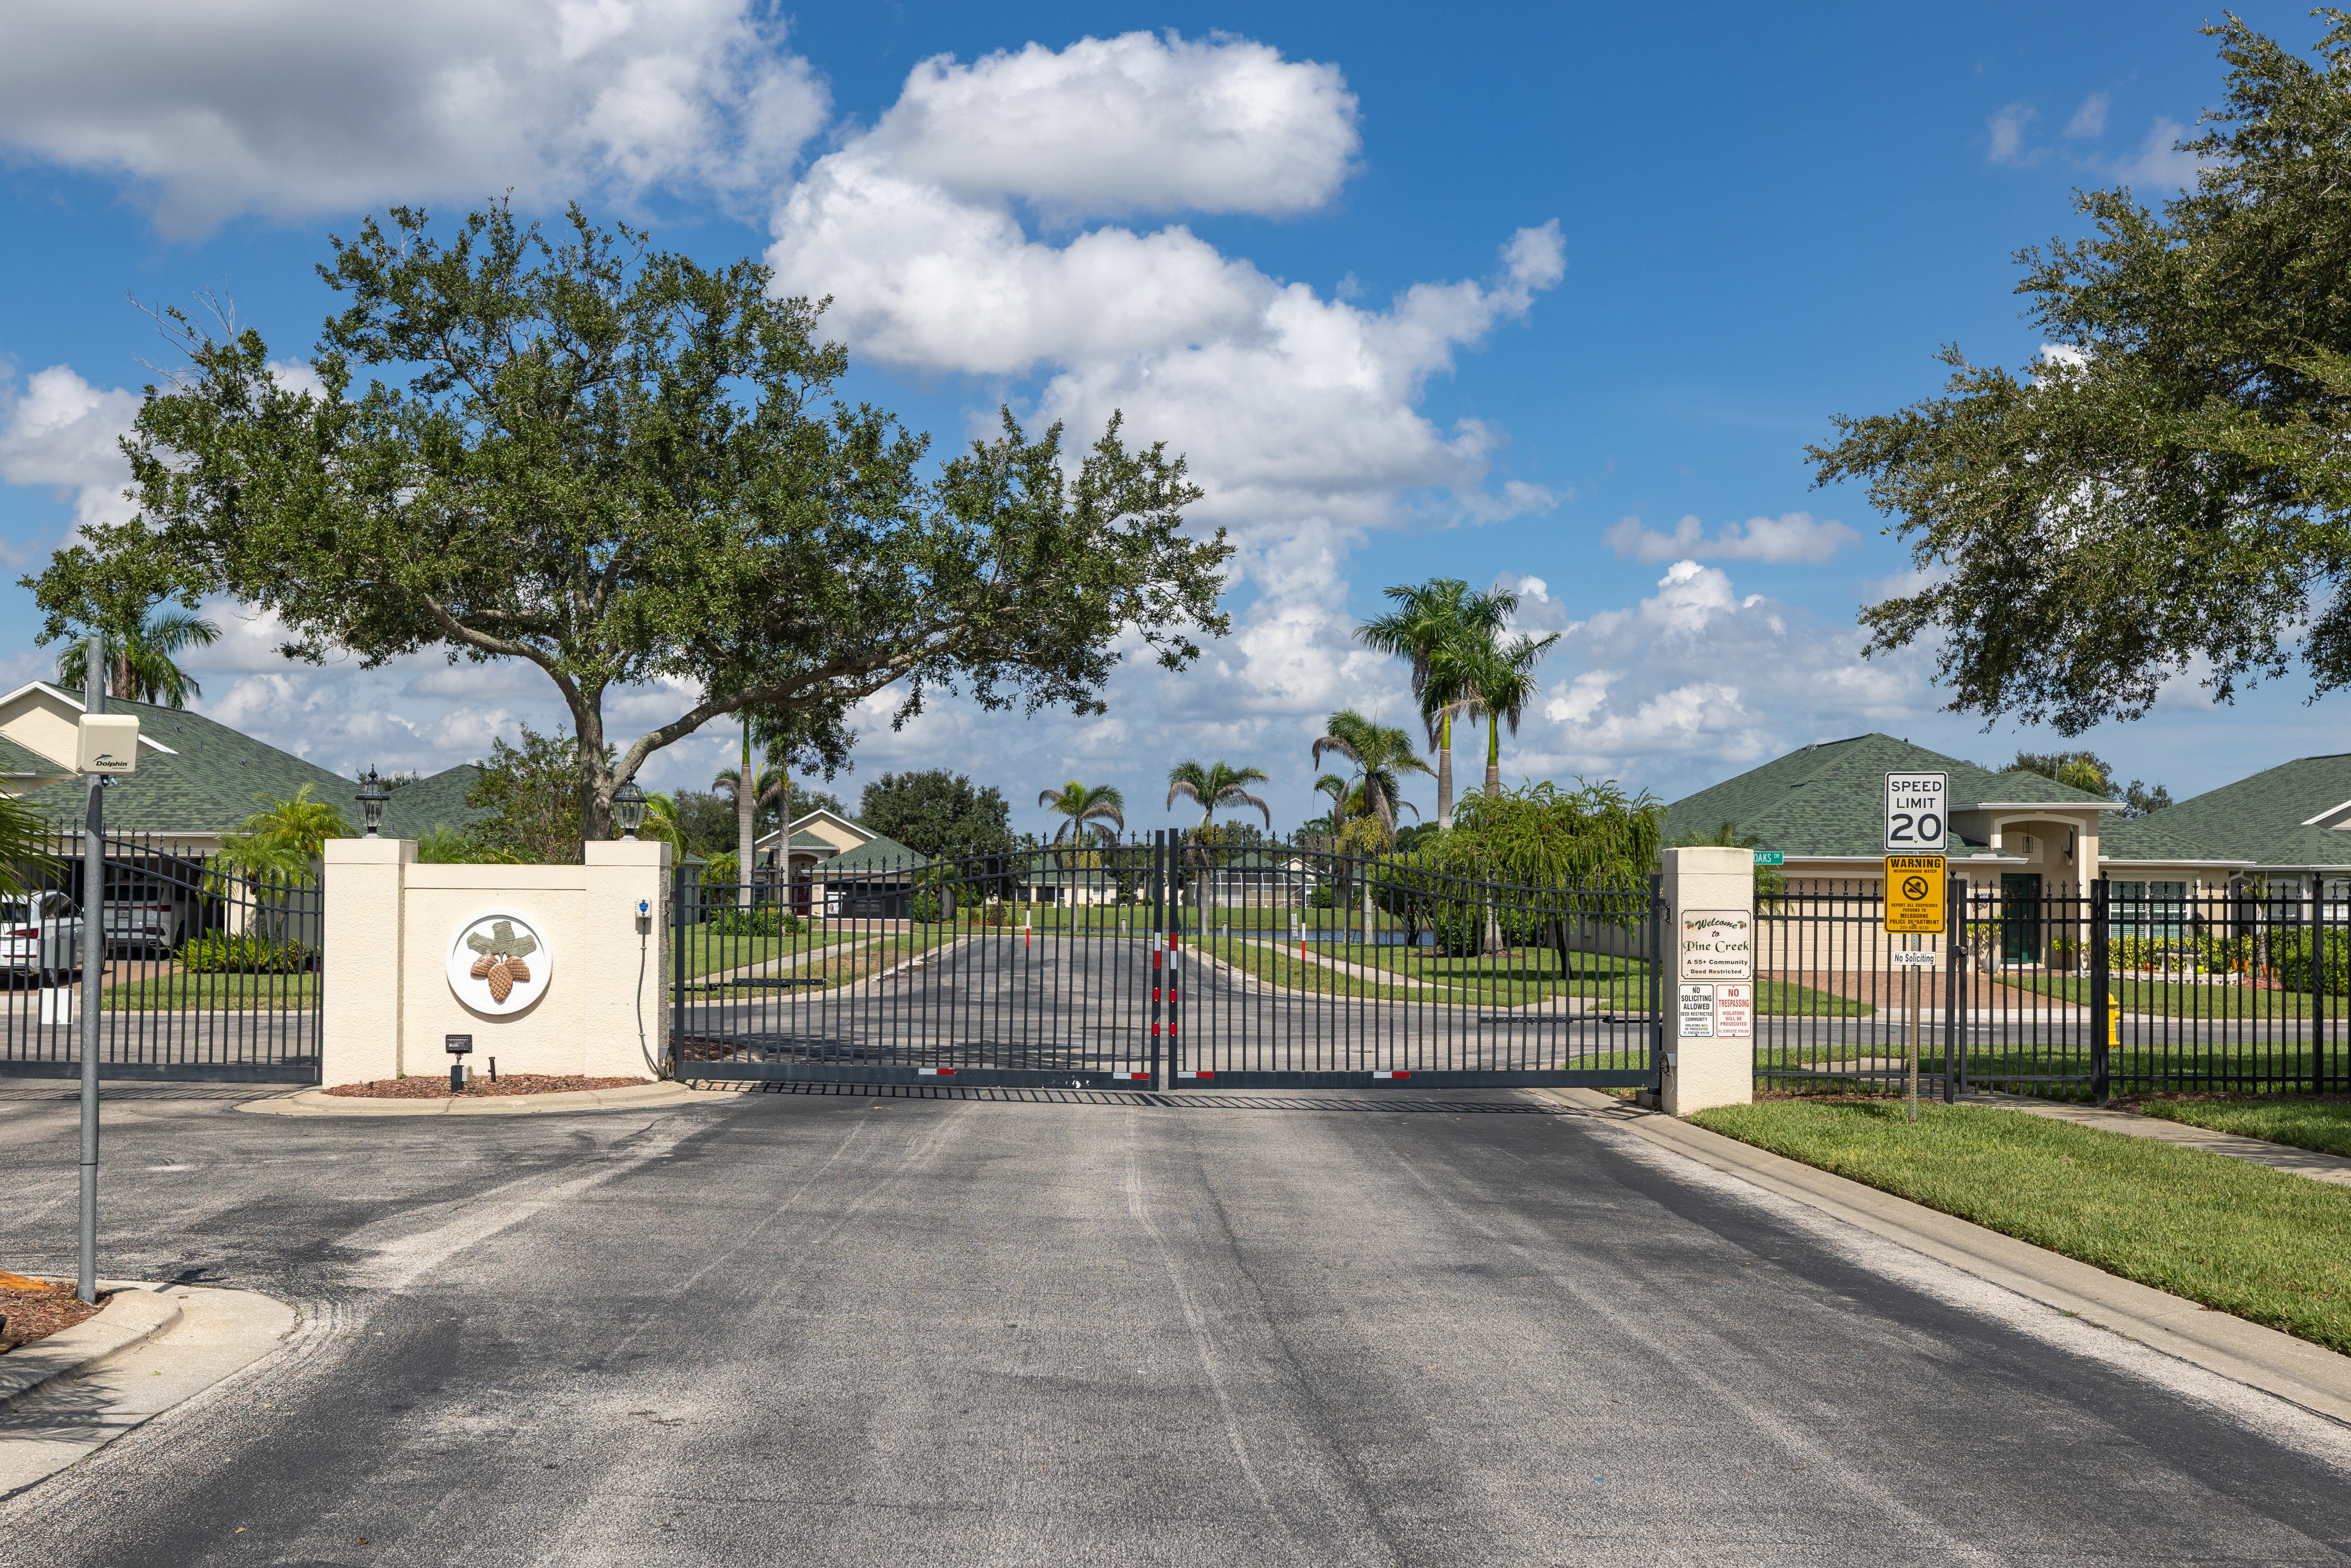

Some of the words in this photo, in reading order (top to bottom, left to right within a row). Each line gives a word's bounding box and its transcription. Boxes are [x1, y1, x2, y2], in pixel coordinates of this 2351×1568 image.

[1891, 781, 1941, 792] SPEED
[1897, 798, 1935, 808] LIMIT
[1890, 813, 1941, 841] 20
[1754, 853, 1771, 863] OAKS
[1890, 859, 1940, 868] WARNING
[1695, 918, 1738, 930] Welcome
[1683, 941, 1711, 955] Pine
[1715, 941, 1749, 952] Creek
[1905, 954, 1934, 964] Soliciting
